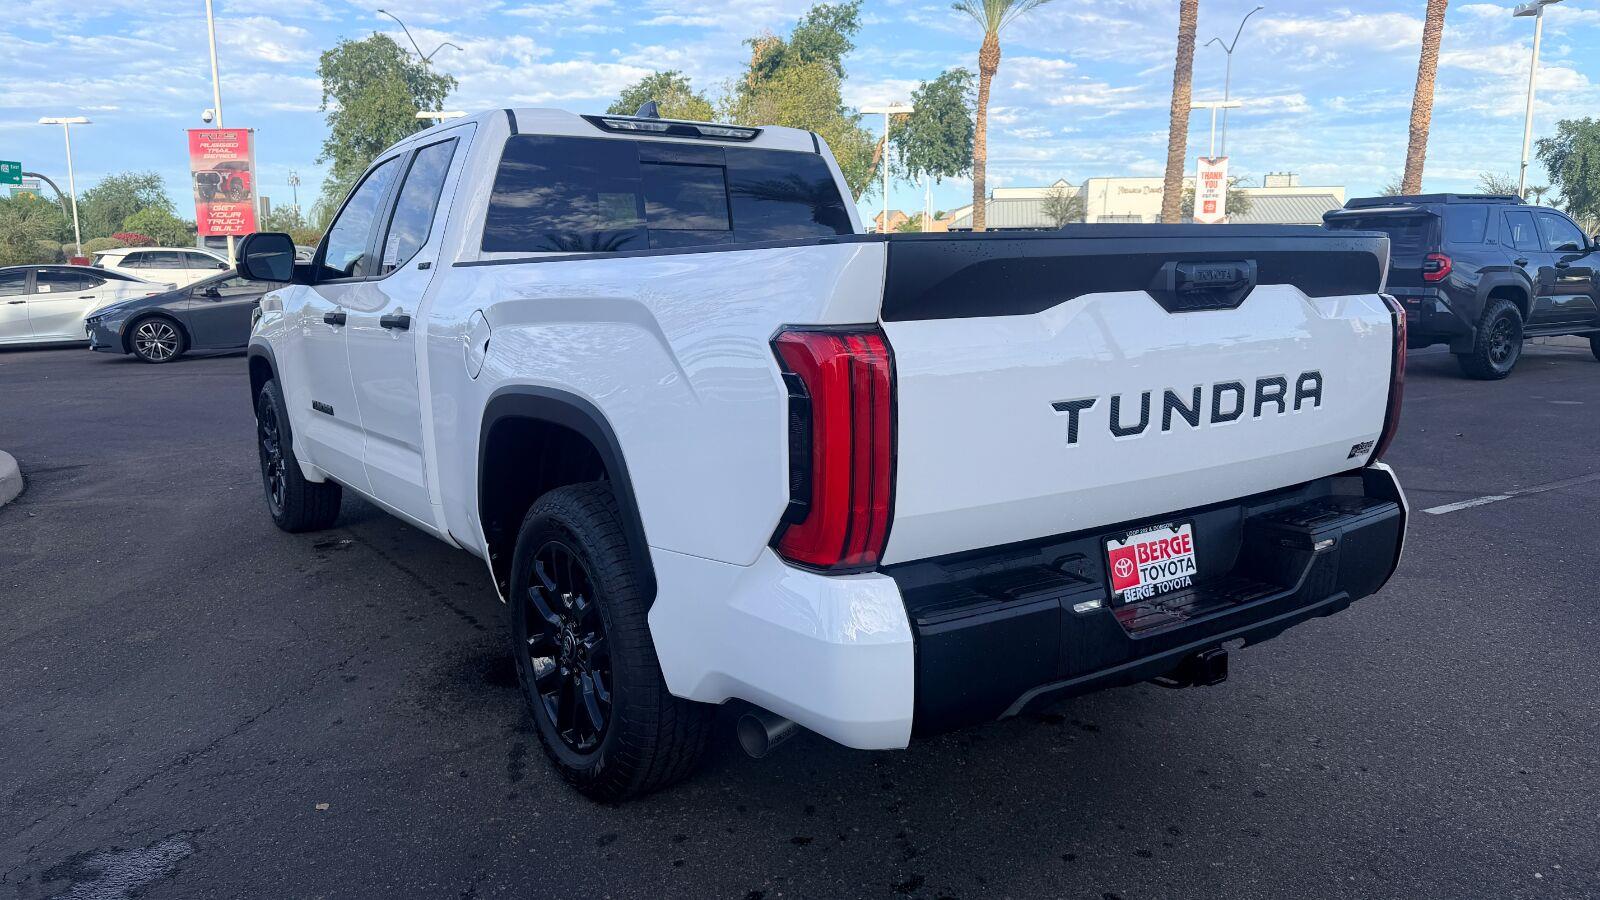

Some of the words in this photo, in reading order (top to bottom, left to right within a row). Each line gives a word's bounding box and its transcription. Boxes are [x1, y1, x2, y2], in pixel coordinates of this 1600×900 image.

[1201, 171, 1223, 180] THANK
[1204, 180, 1218, 189] YOU
[1050, 370, 1323, 446] TUNDRA
[1136, 533, 1192, 564] BERGE
[1140, 557, 1196, 583] TOYOTA
[1123, 584, 1155, 603] BERGE
[1157, 576, 1193, 594] TOYOTA
